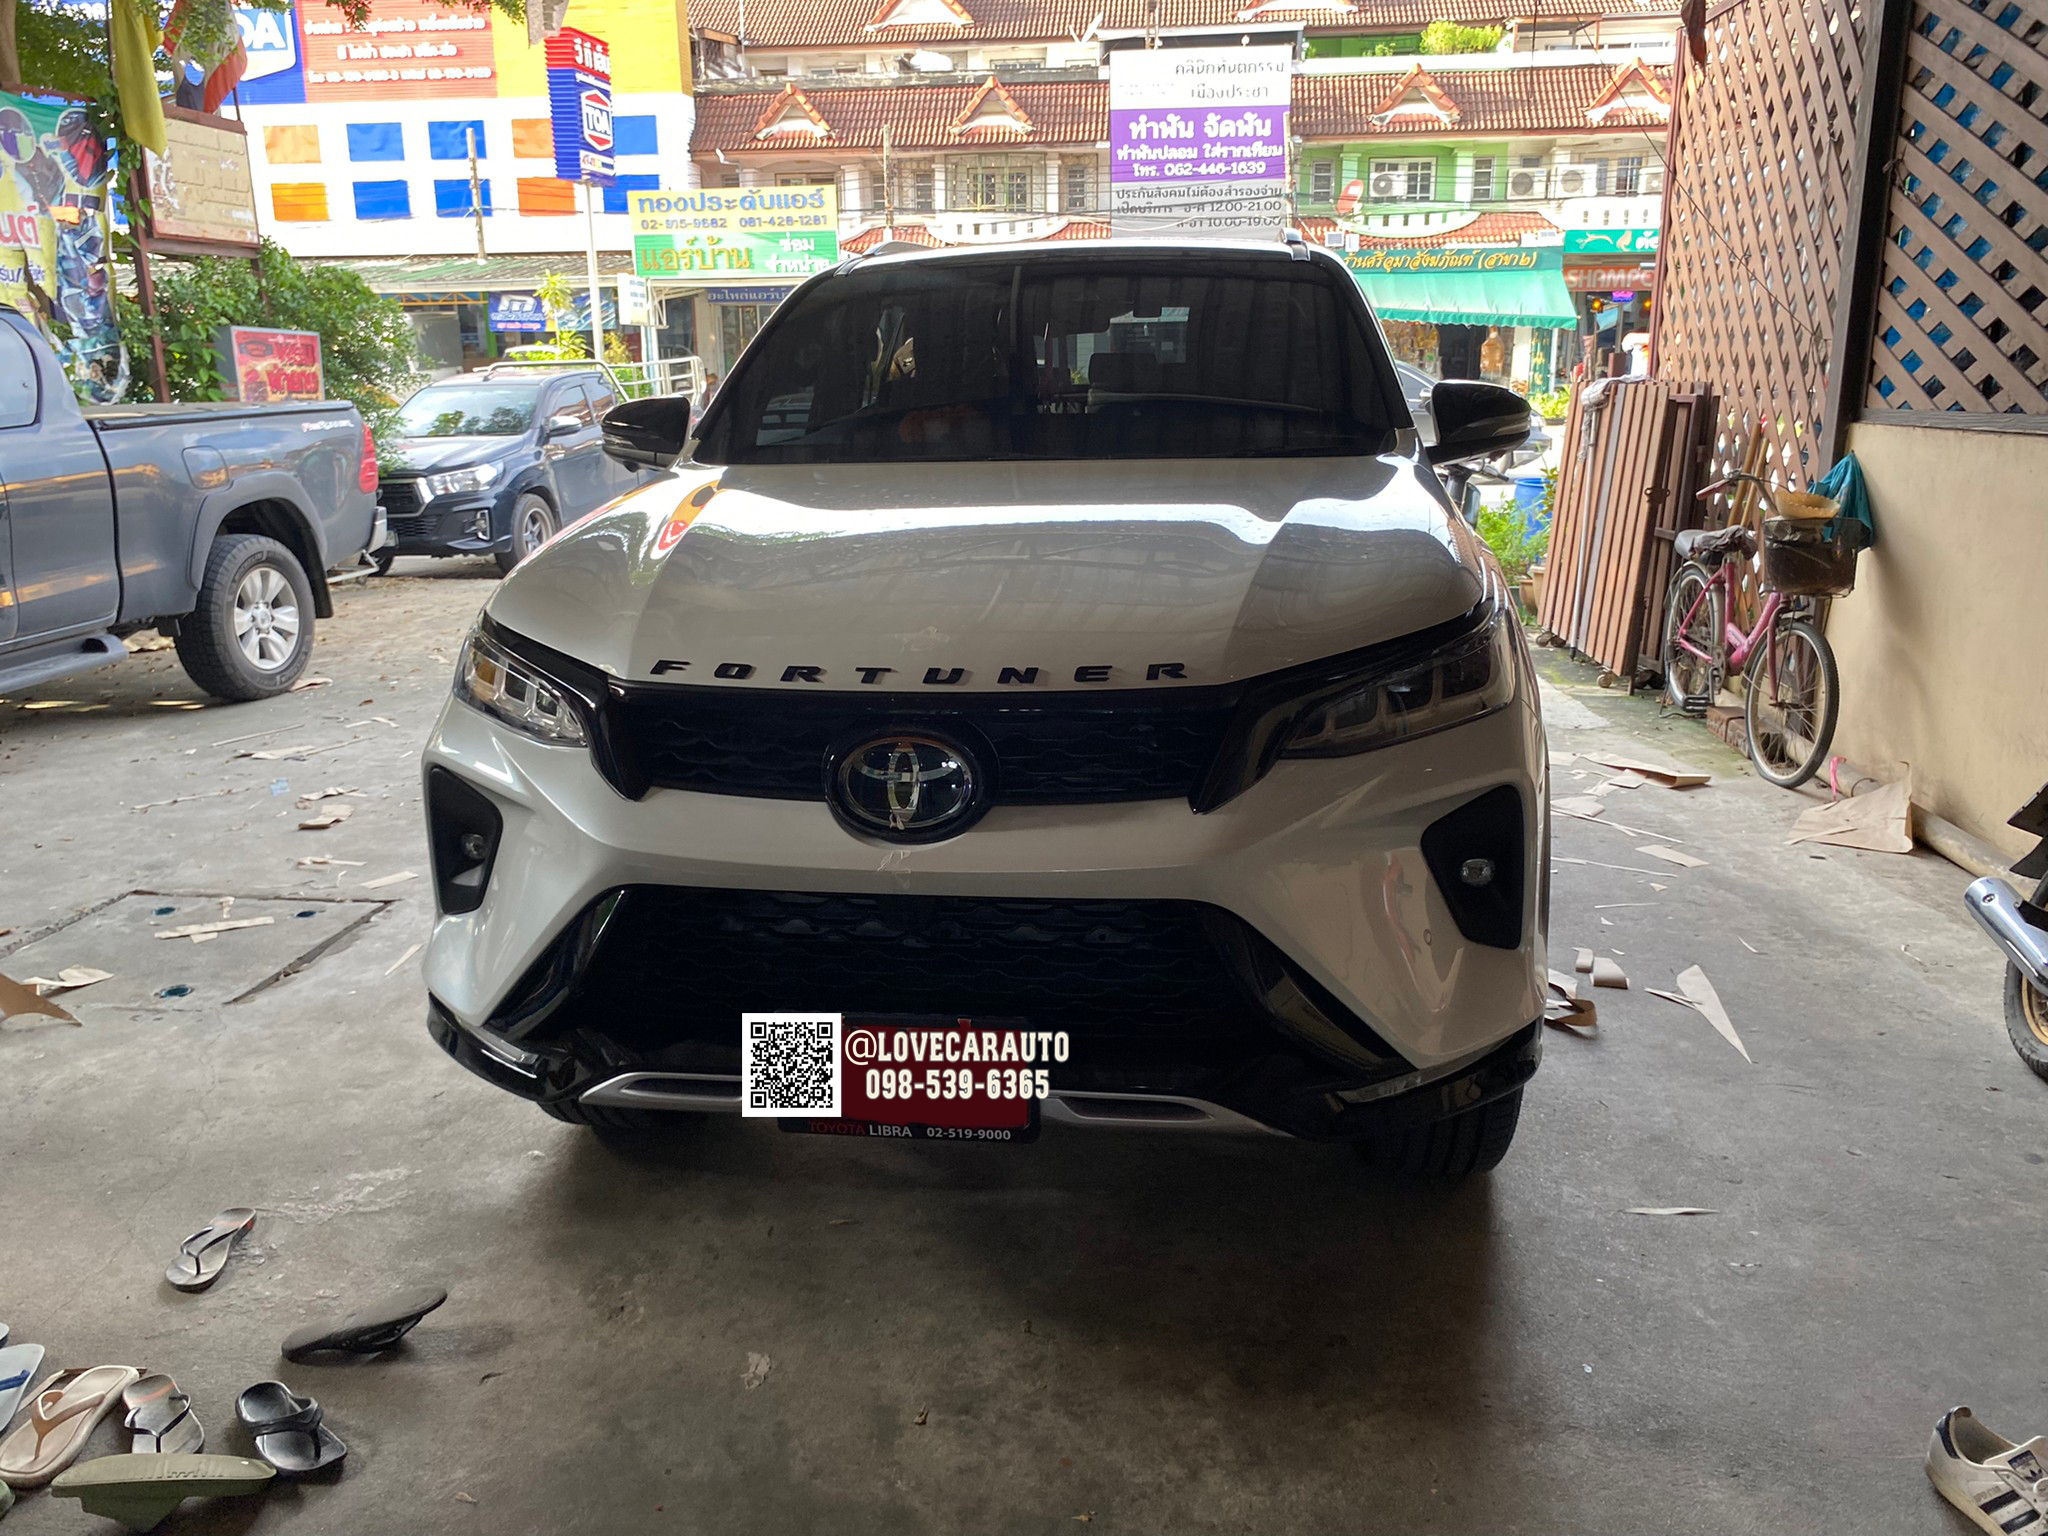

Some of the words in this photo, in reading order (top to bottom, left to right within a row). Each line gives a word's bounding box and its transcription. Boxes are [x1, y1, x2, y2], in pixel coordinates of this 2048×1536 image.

[236, 12, 287, 48] OA
[586, 104, 612, 136] TOA
[1129, 113, 1195, 139] ทำฟัน
[1203, 111, 1272, 138] จัดฟัน
[1117, 143, 1198, 160] ทำฟันปลอม
[638, 187, 826, 213] ทองประดับแอร์
[641, 235, 751, 271] แอร์บ้าน
[650, 660, 1188, 685] FORTUNER
[809, 1122, 866, 1135] TOYOTA
[869, 1124, 912, 1138] LIBRA
[926, 1126, 1011, 1141] 02-519-9000
